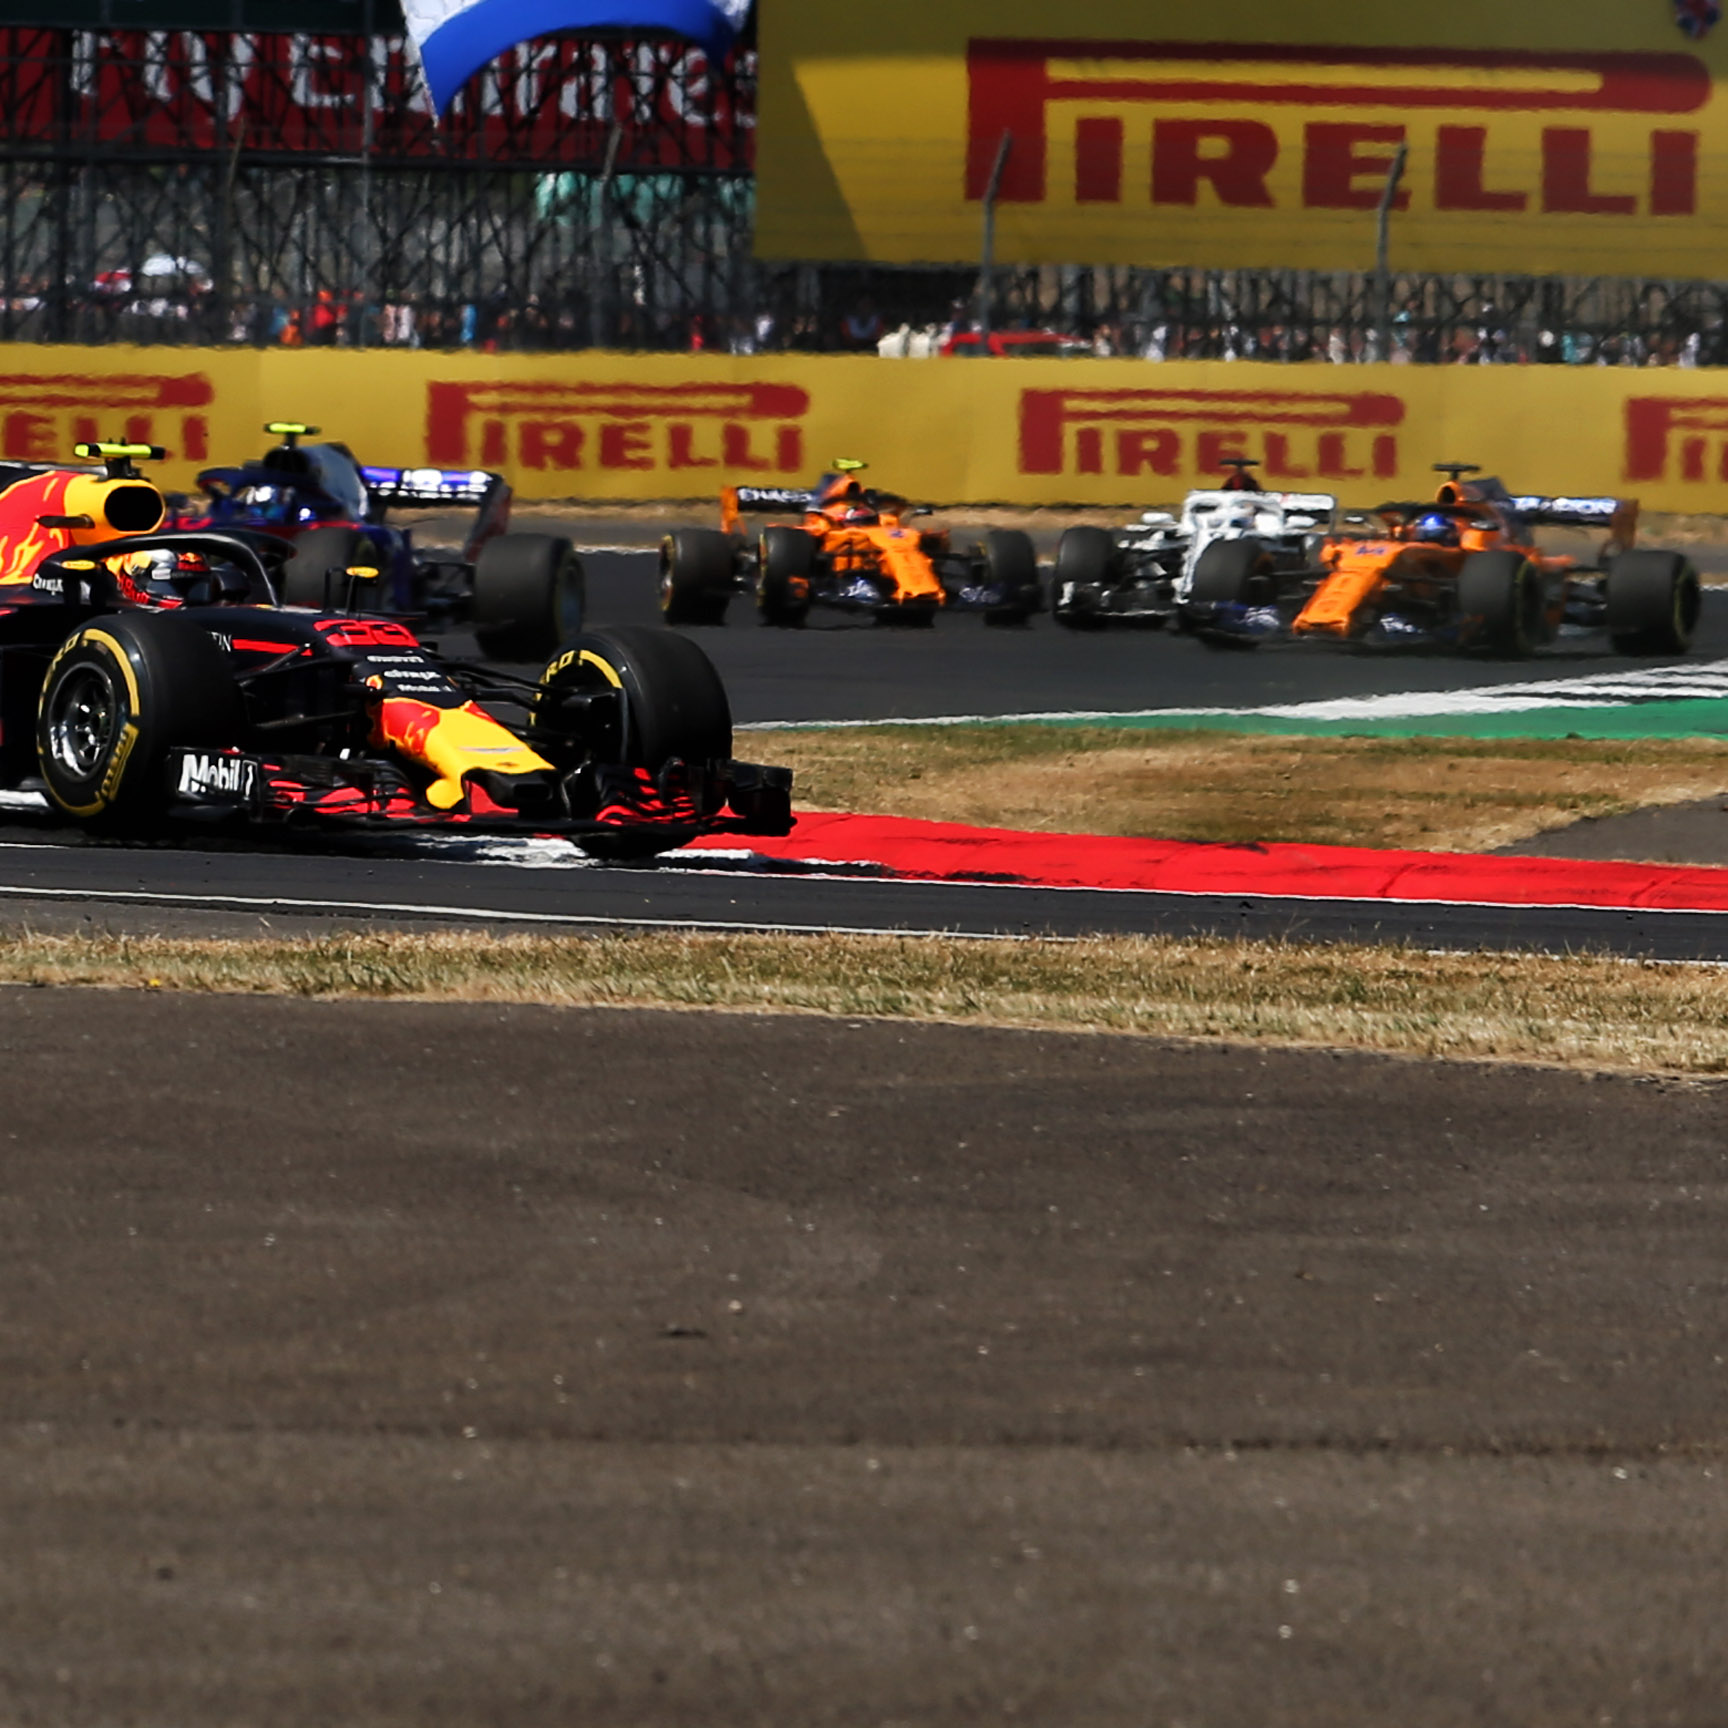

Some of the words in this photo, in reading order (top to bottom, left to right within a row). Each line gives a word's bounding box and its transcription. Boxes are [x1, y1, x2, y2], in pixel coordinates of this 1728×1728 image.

[966, 39, 1708, 214] PIRELLI
[426, 382, 810, 473] PIRELLI
[1019, 388, 1405, 478] PIRELLI
[313, 620, 421, 647] 33
[178, 754, 242, 794] Mobil
